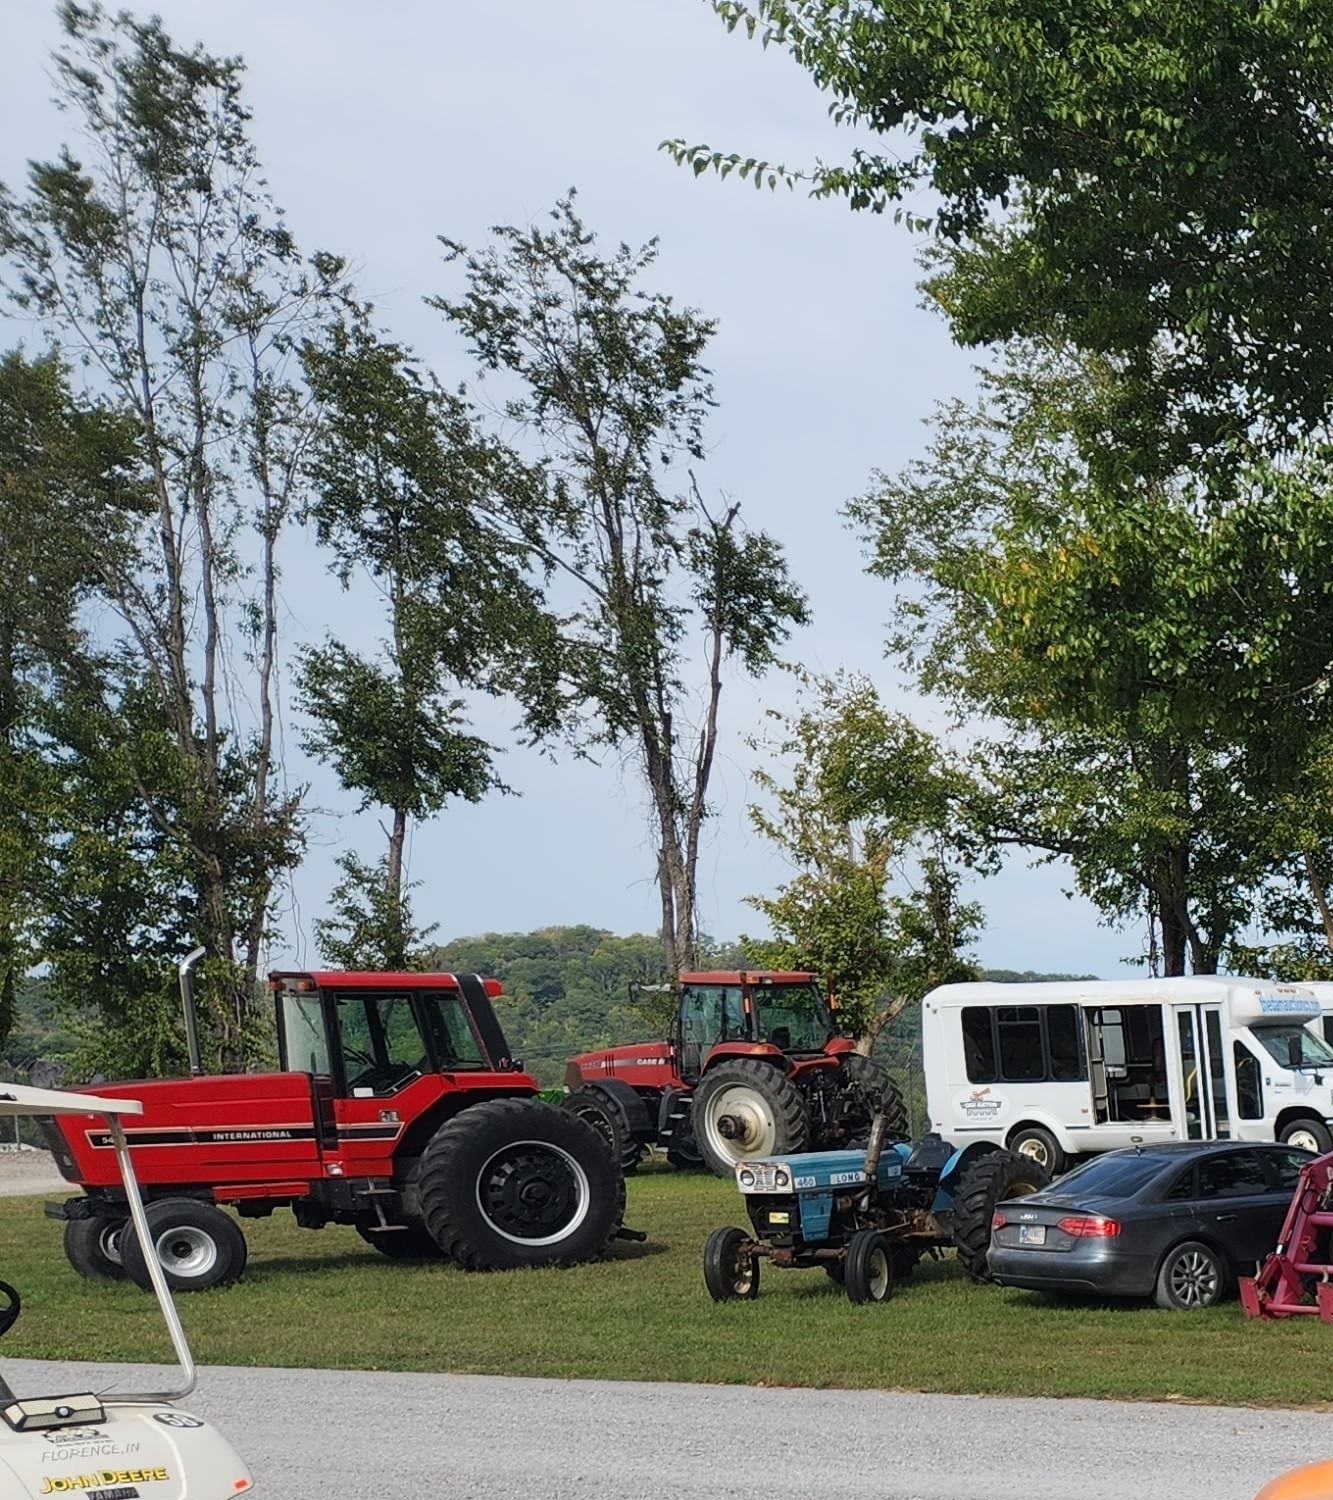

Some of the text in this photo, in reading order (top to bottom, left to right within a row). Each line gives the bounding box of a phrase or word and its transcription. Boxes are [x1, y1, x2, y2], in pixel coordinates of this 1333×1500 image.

[212, 1129, 292, 1141] INTERNATIONAL
[836, 1172, 861, 1183] LONG
[40, 1467, 170, 1494] JOHN DEERE
